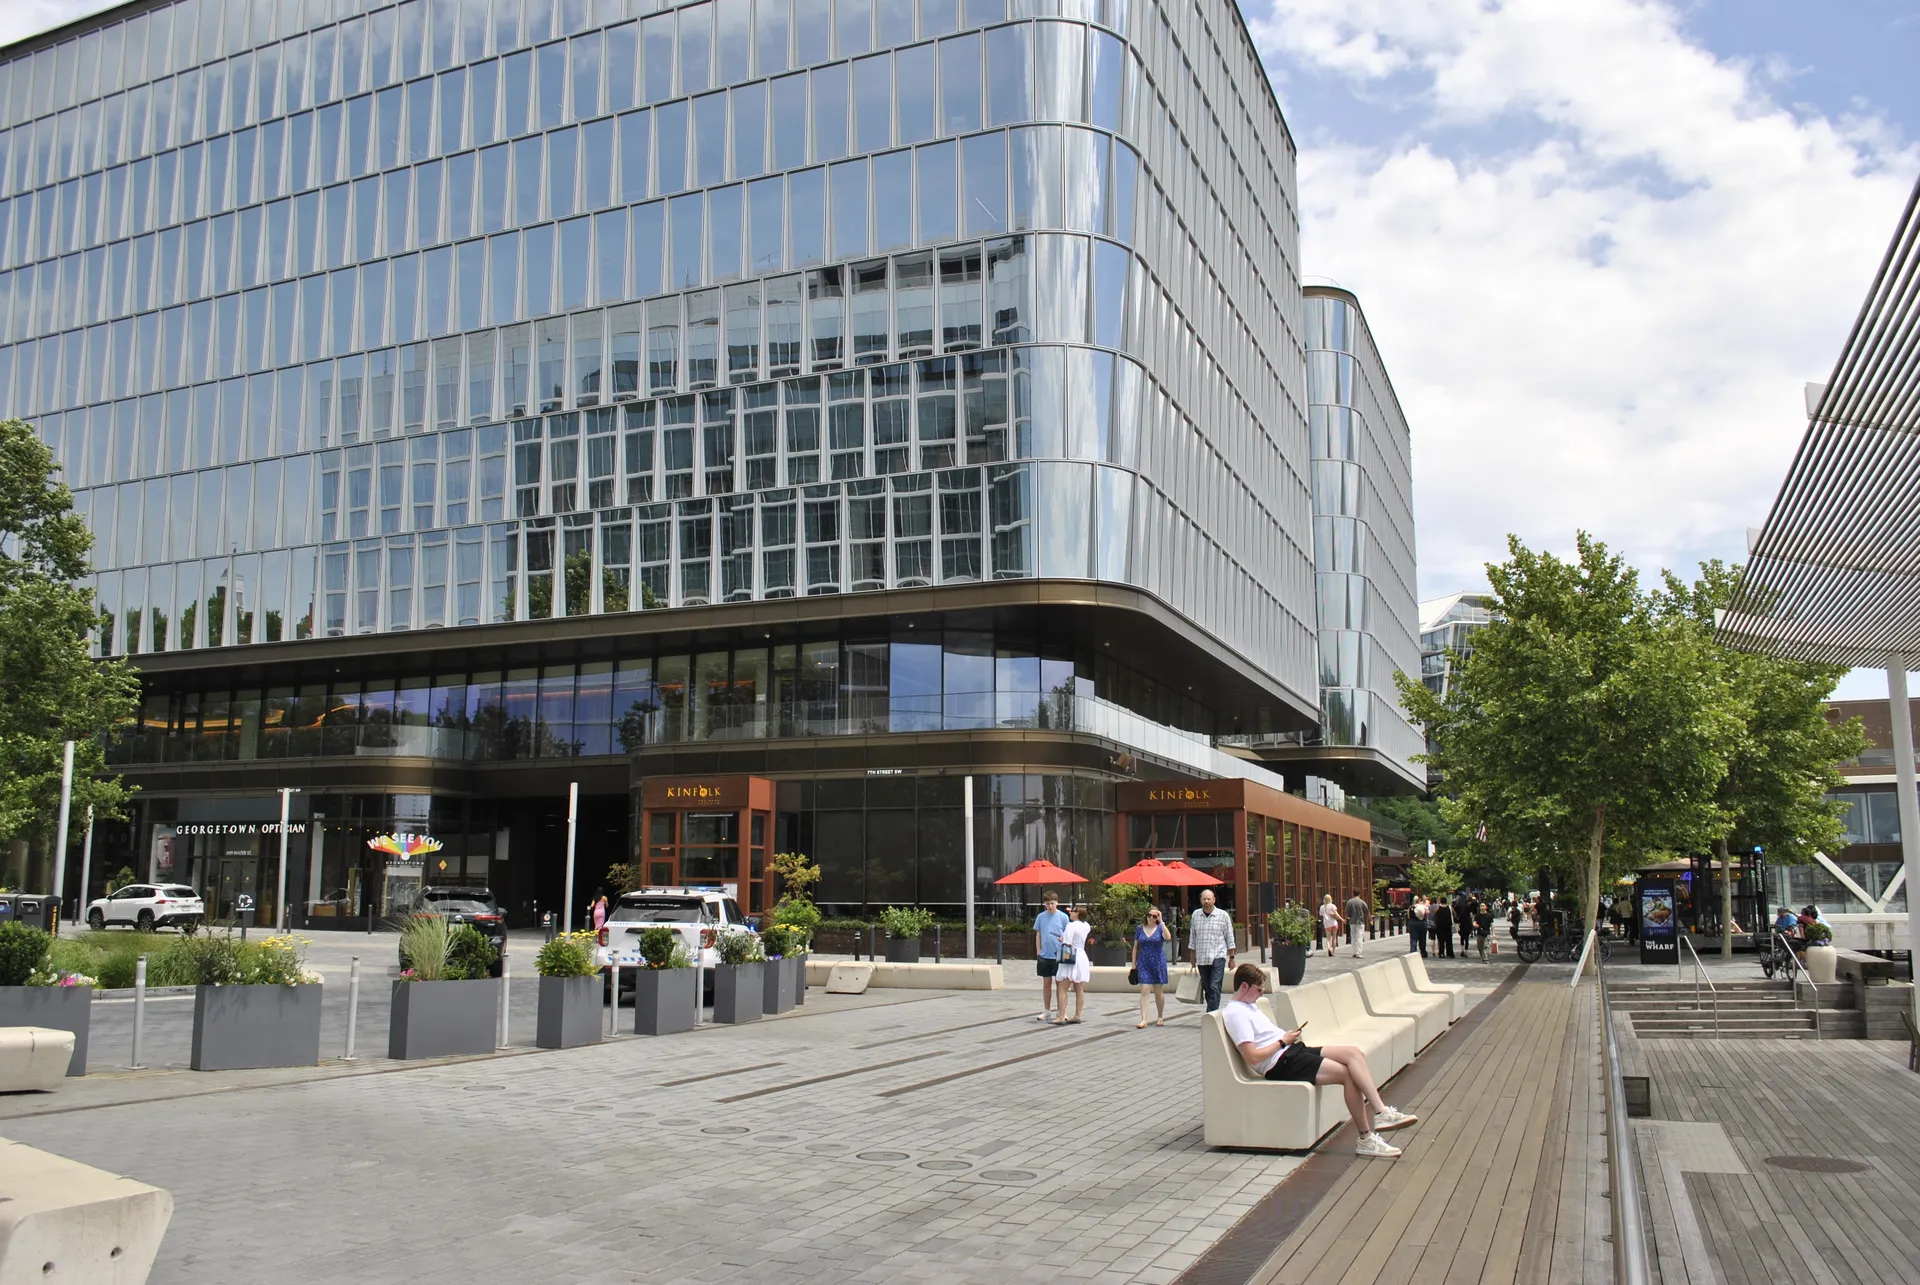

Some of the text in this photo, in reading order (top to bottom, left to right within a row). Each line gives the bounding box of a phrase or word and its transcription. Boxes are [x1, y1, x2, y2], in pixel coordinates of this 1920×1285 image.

[667, 785, 721, 797] KINFOLK
[1149, 787, 1210, 800] KINFOLK
[176, 824, 257, 834] GEORGETOWN
[367, 832, 443, 851] WE SEE YOU
